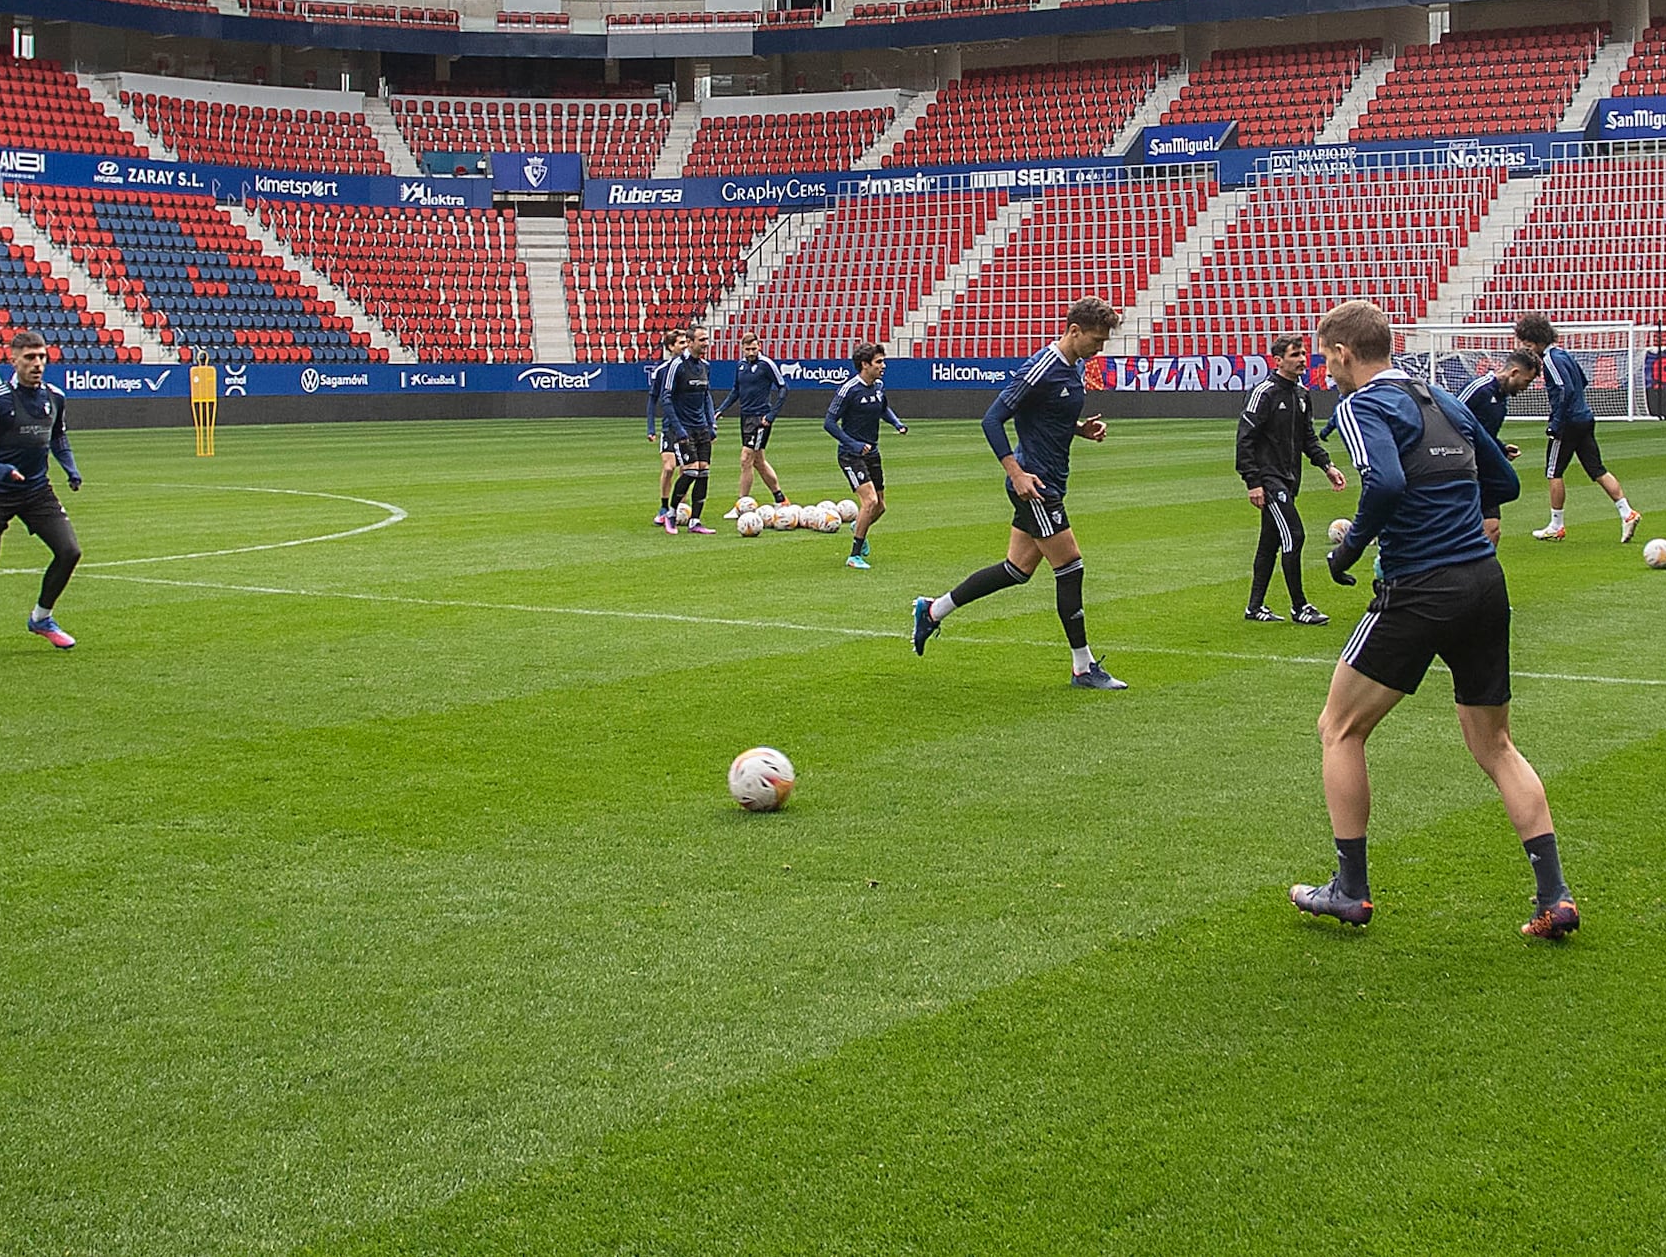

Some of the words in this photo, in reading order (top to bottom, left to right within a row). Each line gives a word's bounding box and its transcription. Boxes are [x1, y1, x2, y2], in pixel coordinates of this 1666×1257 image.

[1148, 136, 1215, 155] SanMiguel
[1297, 148, 1339, 162] DIARIO
[1339, 146, 1357, 160] DE
[1447, 147, 1526, 169] Noticias
[127, 167, 175, 185] ZARAY
[177, 172, 205, 188] S.L.
[1016, 168, 1065, 187] SEUR
[608, 184, 683, 205] Rubersa
[320, 373, 369, 389] Sagamóvil
